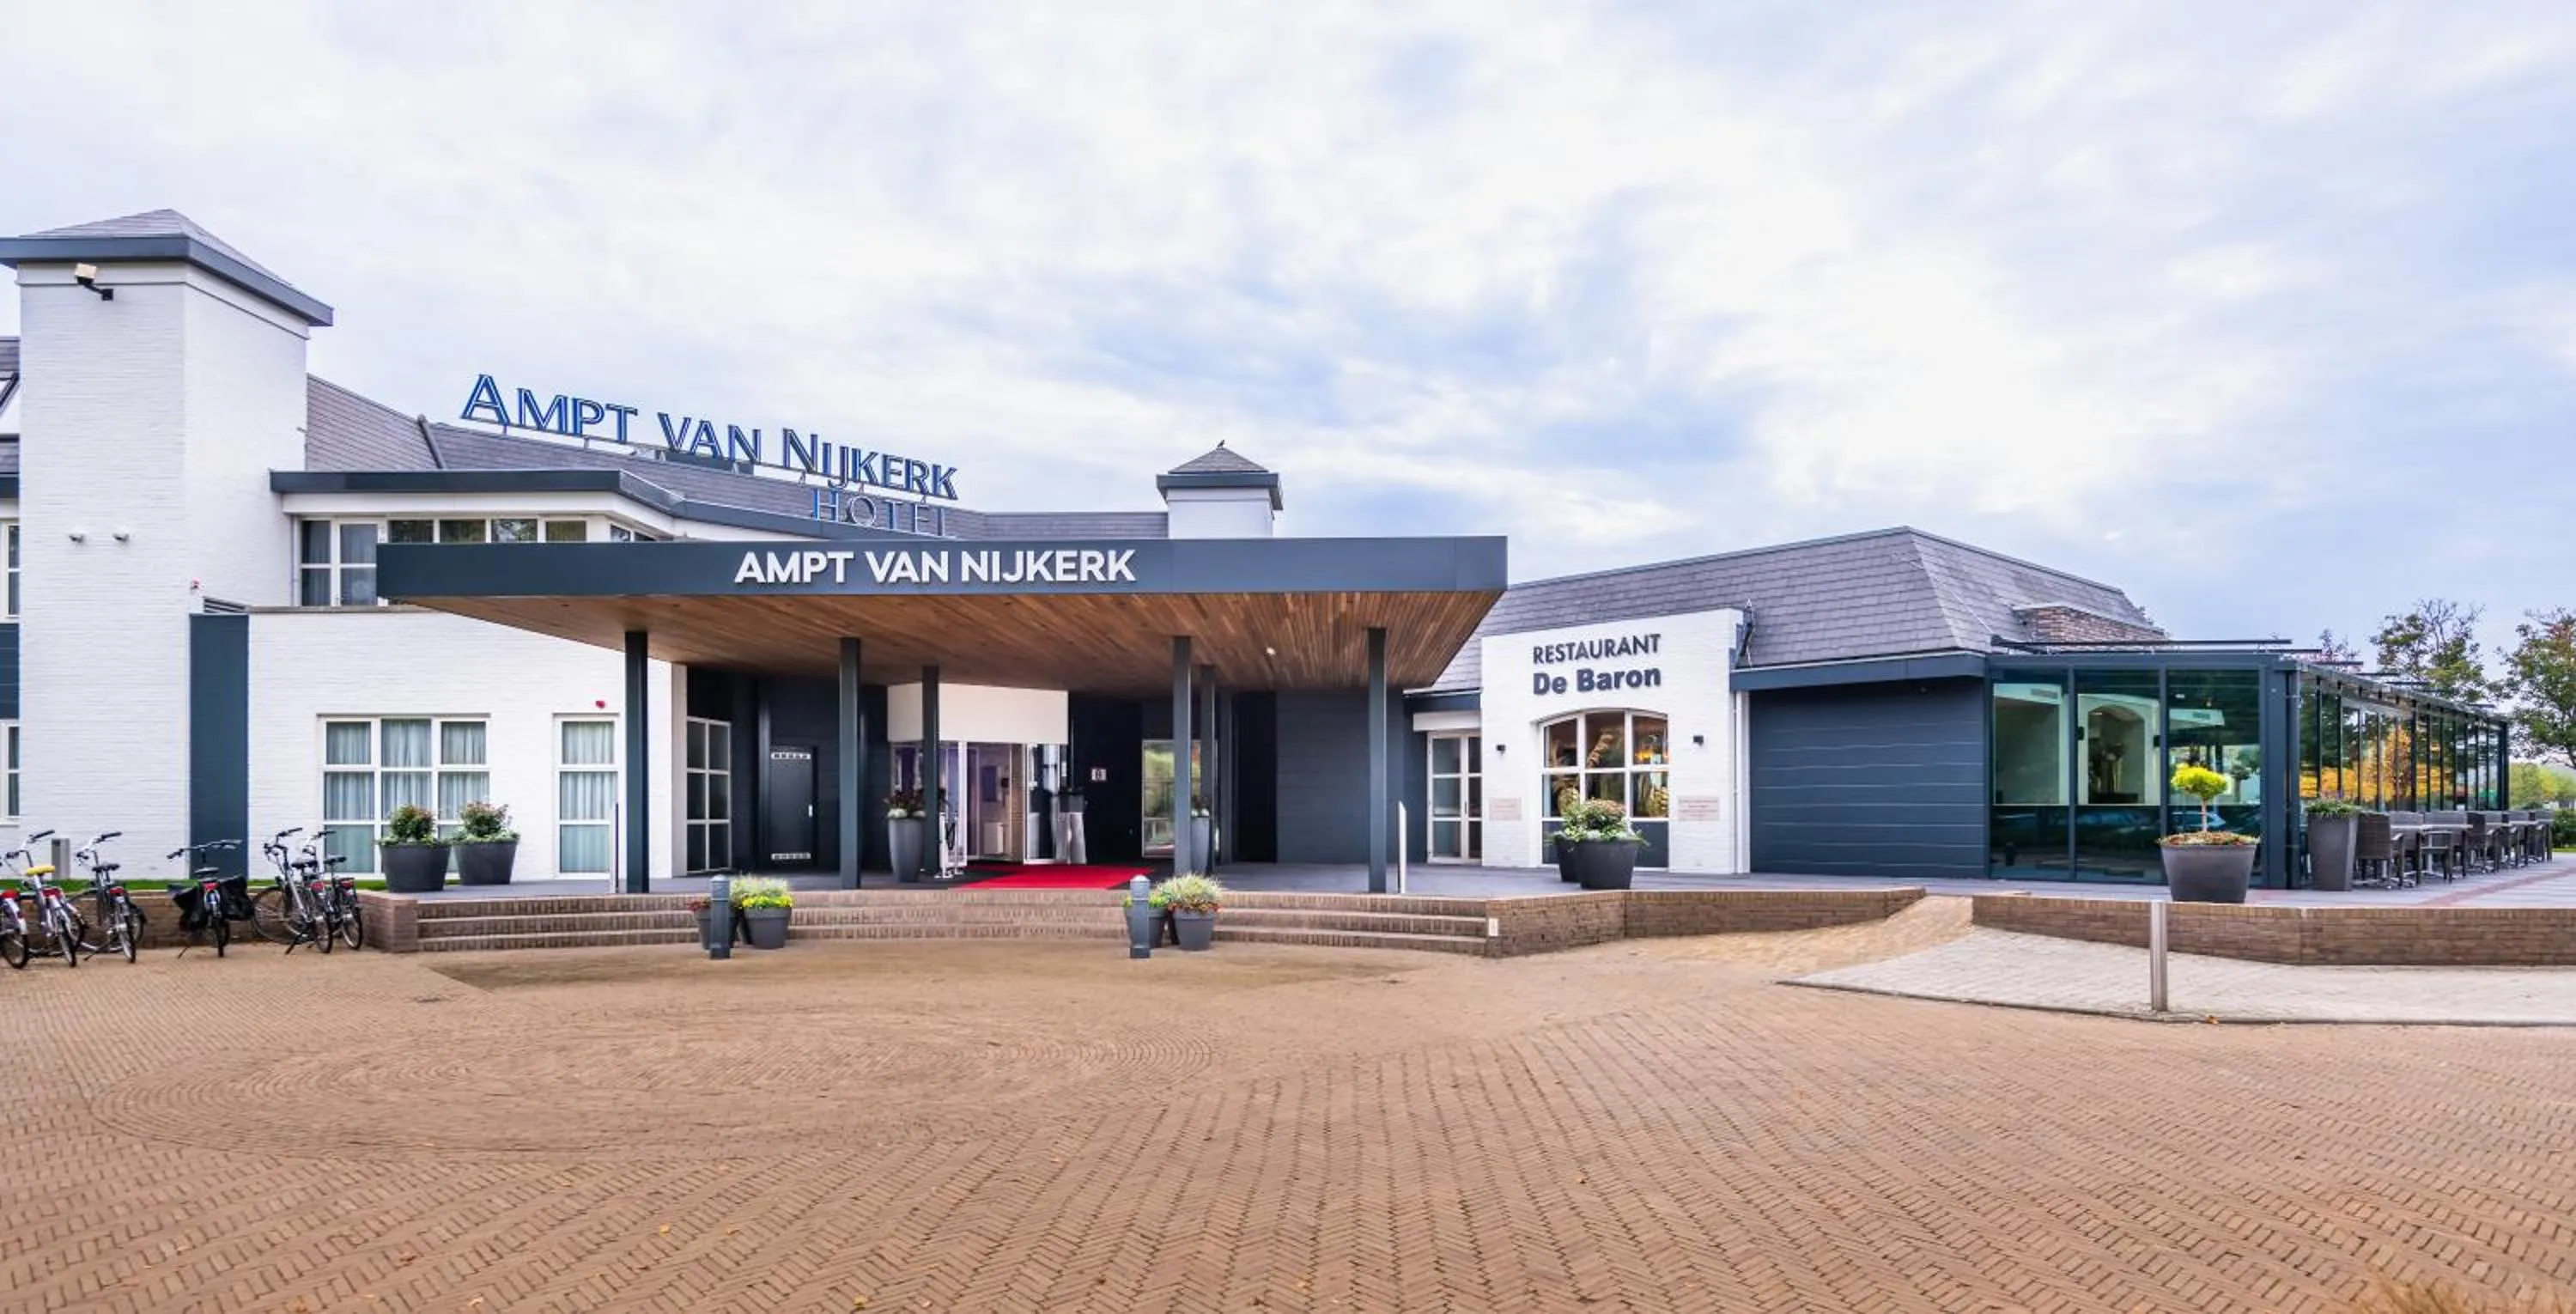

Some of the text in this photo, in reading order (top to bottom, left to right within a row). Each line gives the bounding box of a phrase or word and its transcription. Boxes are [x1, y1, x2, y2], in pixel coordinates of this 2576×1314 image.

[460, 374, 958, 500] AMPT VAN NIJKERK
[734, 550, 1136, 583] AMPT VAN NIJKERK
[1533, 634, 1662, 664] RESTAURANT
[1533, 667, 1662, 695] De Baron
